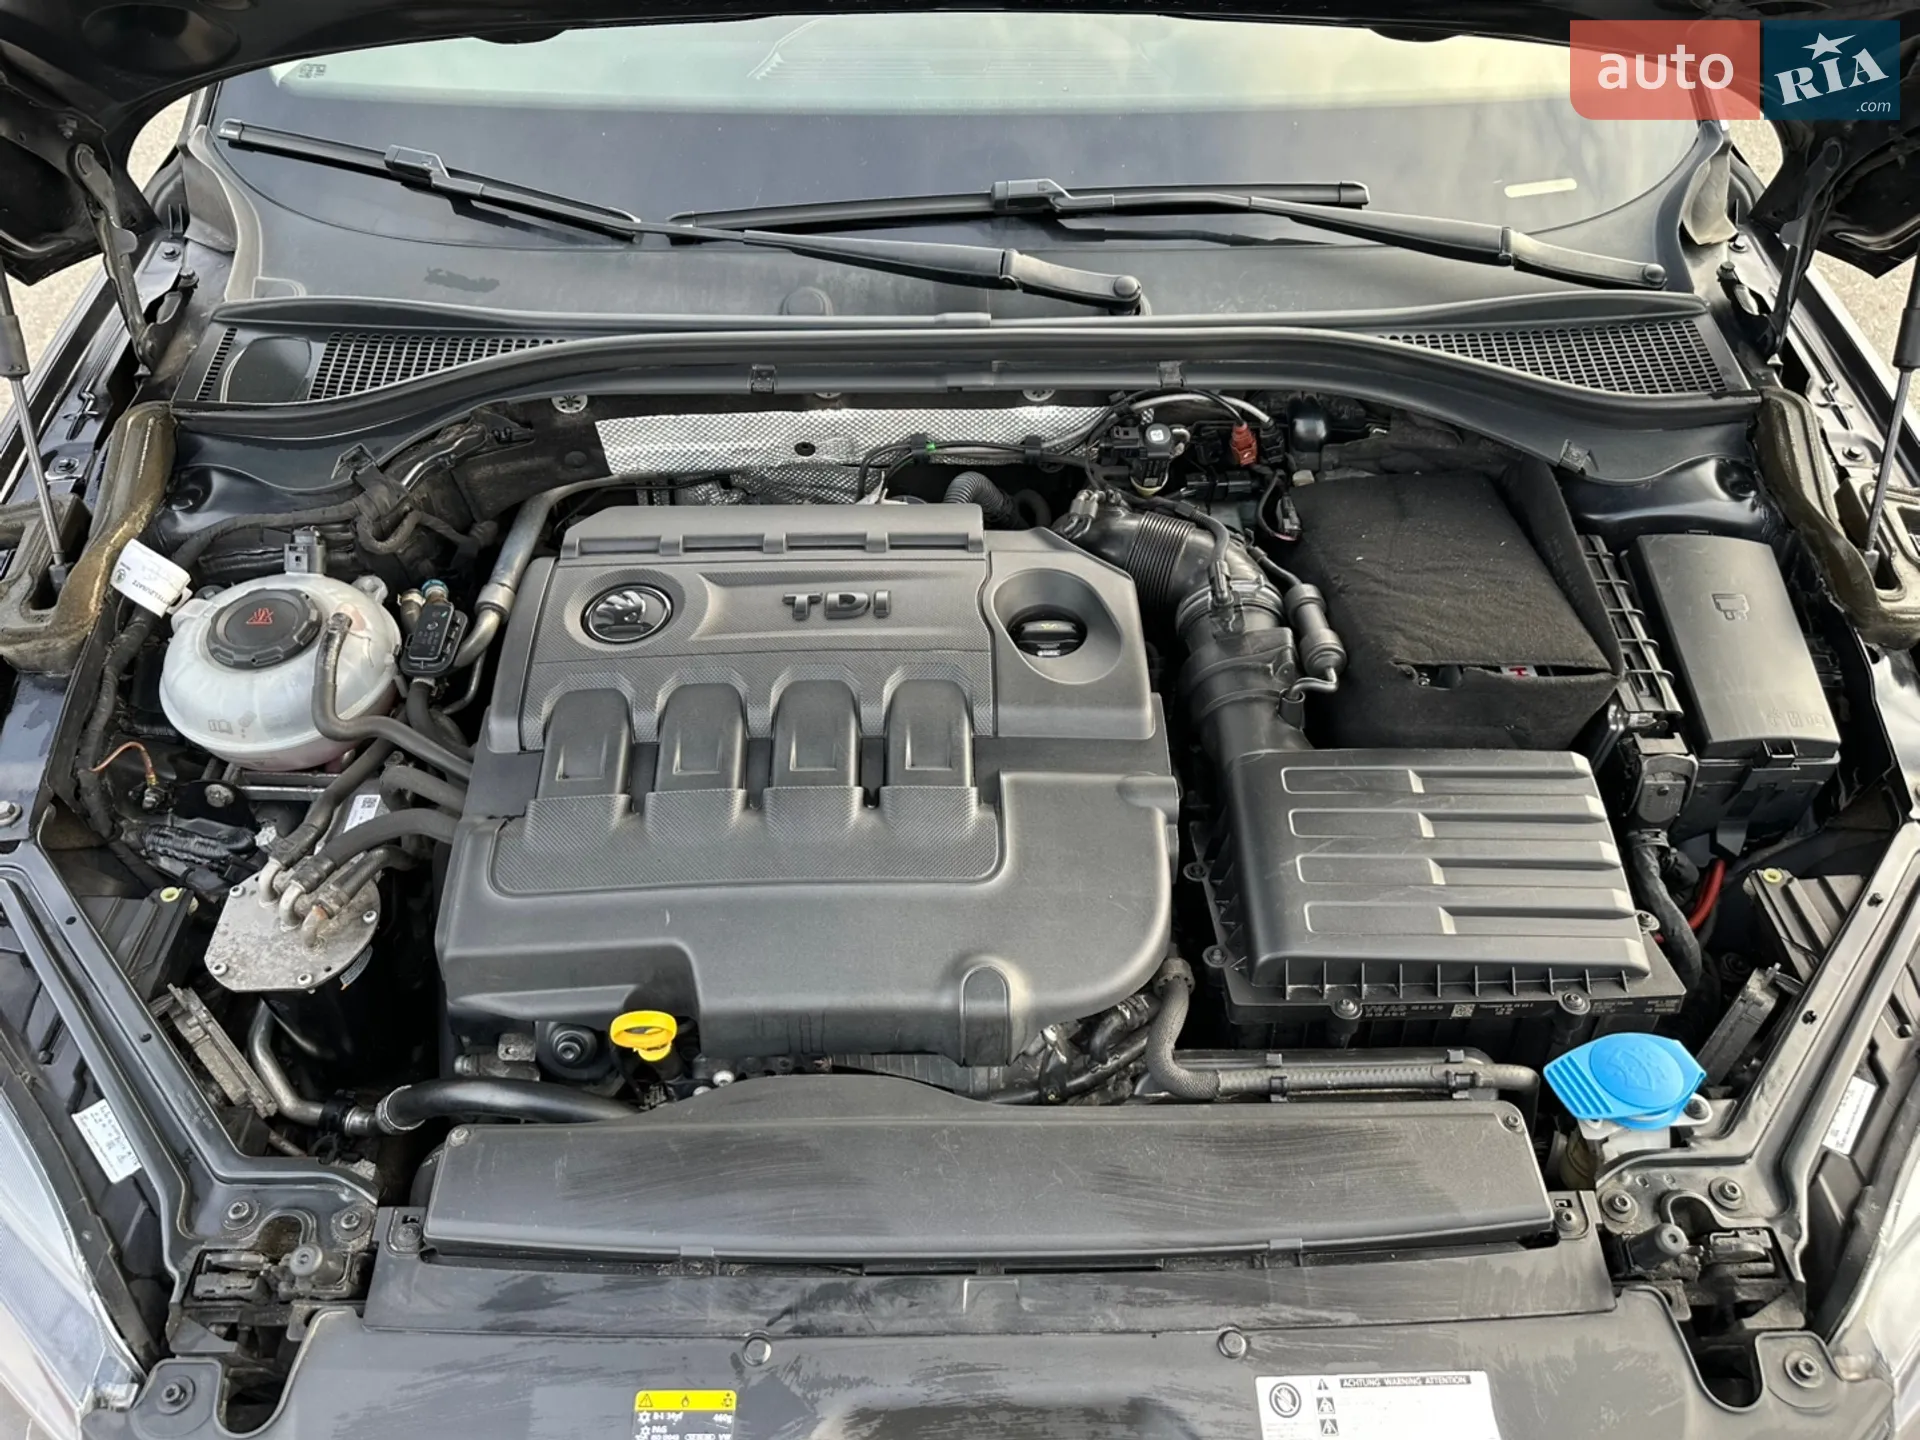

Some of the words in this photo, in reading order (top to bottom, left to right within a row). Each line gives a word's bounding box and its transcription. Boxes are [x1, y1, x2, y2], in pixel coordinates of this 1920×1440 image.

[781, 589, 892, 621] TDI
[1342, 1378, 1381, 1388] ACHTUNG
[1384, 1377, 1422, 1386] WARNING
[1425, 1376, 1467, 1385] ATTENTION
